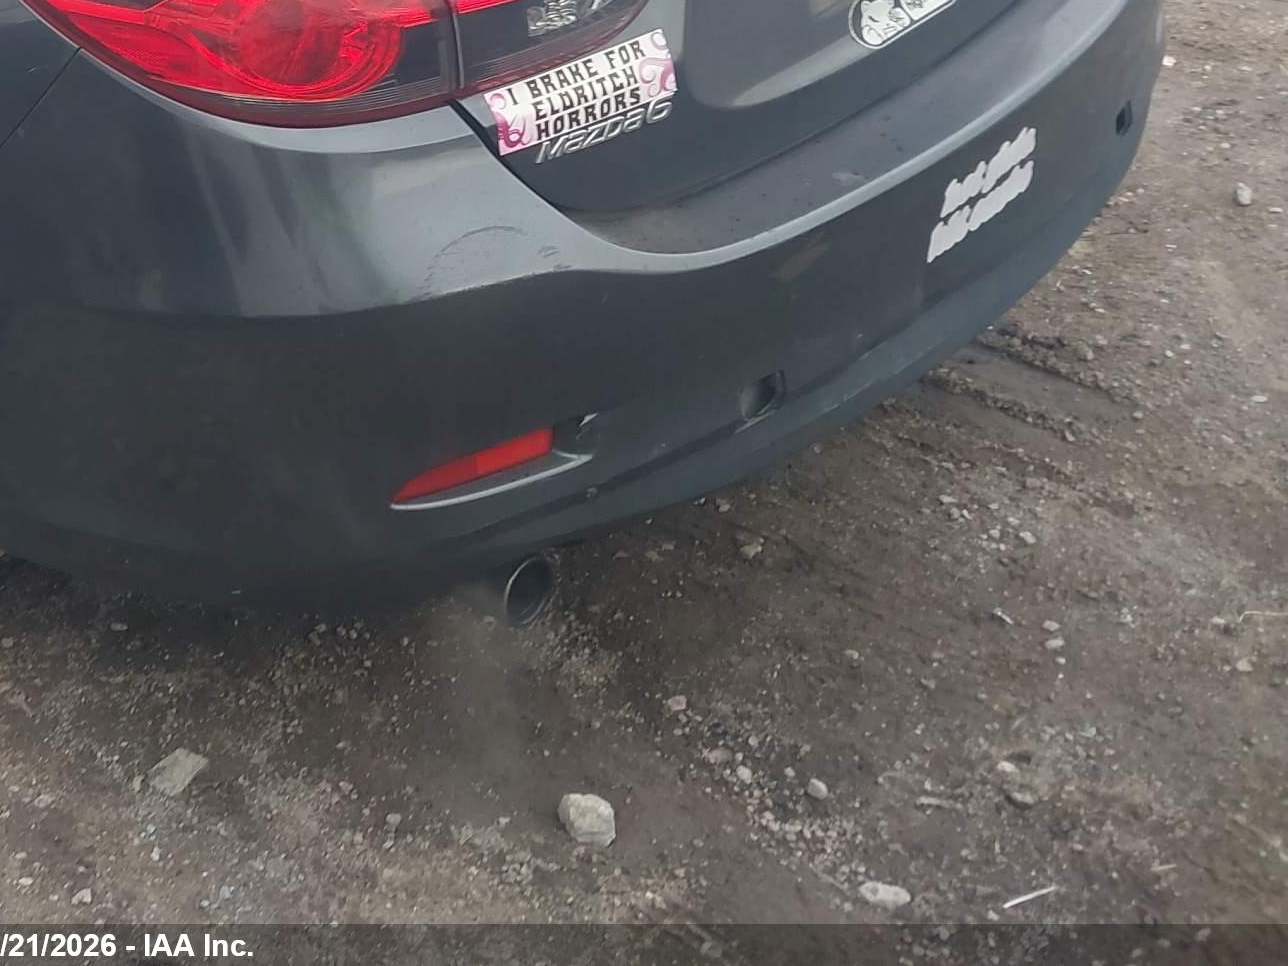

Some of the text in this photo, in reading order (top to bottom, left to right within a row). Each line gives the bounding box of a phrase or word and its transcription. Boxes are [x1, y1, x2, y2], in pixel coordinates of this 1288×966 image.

[506, 39, 646, 106] I BRAKE FOR
[531, 65, 639, 122] ELDRITCH
[535, 86, 641, 141] HORRORS
